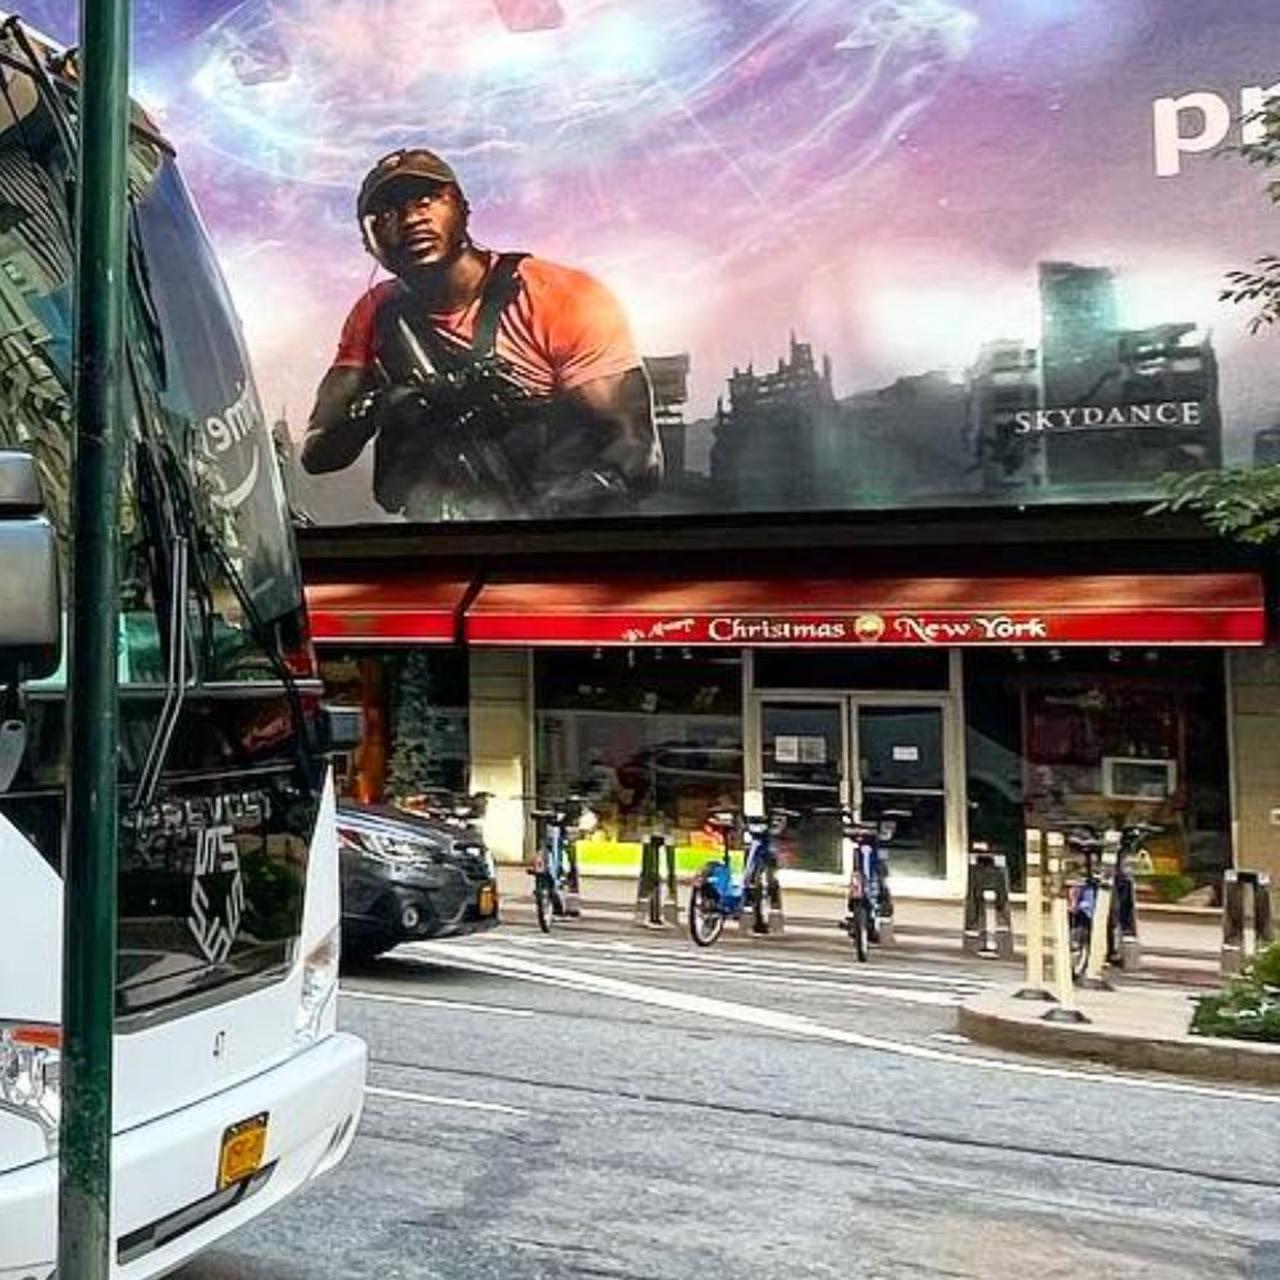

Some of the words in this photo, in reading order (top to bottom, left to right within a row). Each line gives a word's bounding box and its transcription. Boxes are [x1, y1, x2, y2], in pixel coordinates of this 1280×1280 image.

[1015, 400, 1202, 434] SKYDANCE
[708, 617, 847, 641] Christmas
[894, 617, 971, 643] New
[976, 616, 1047, 638] York
